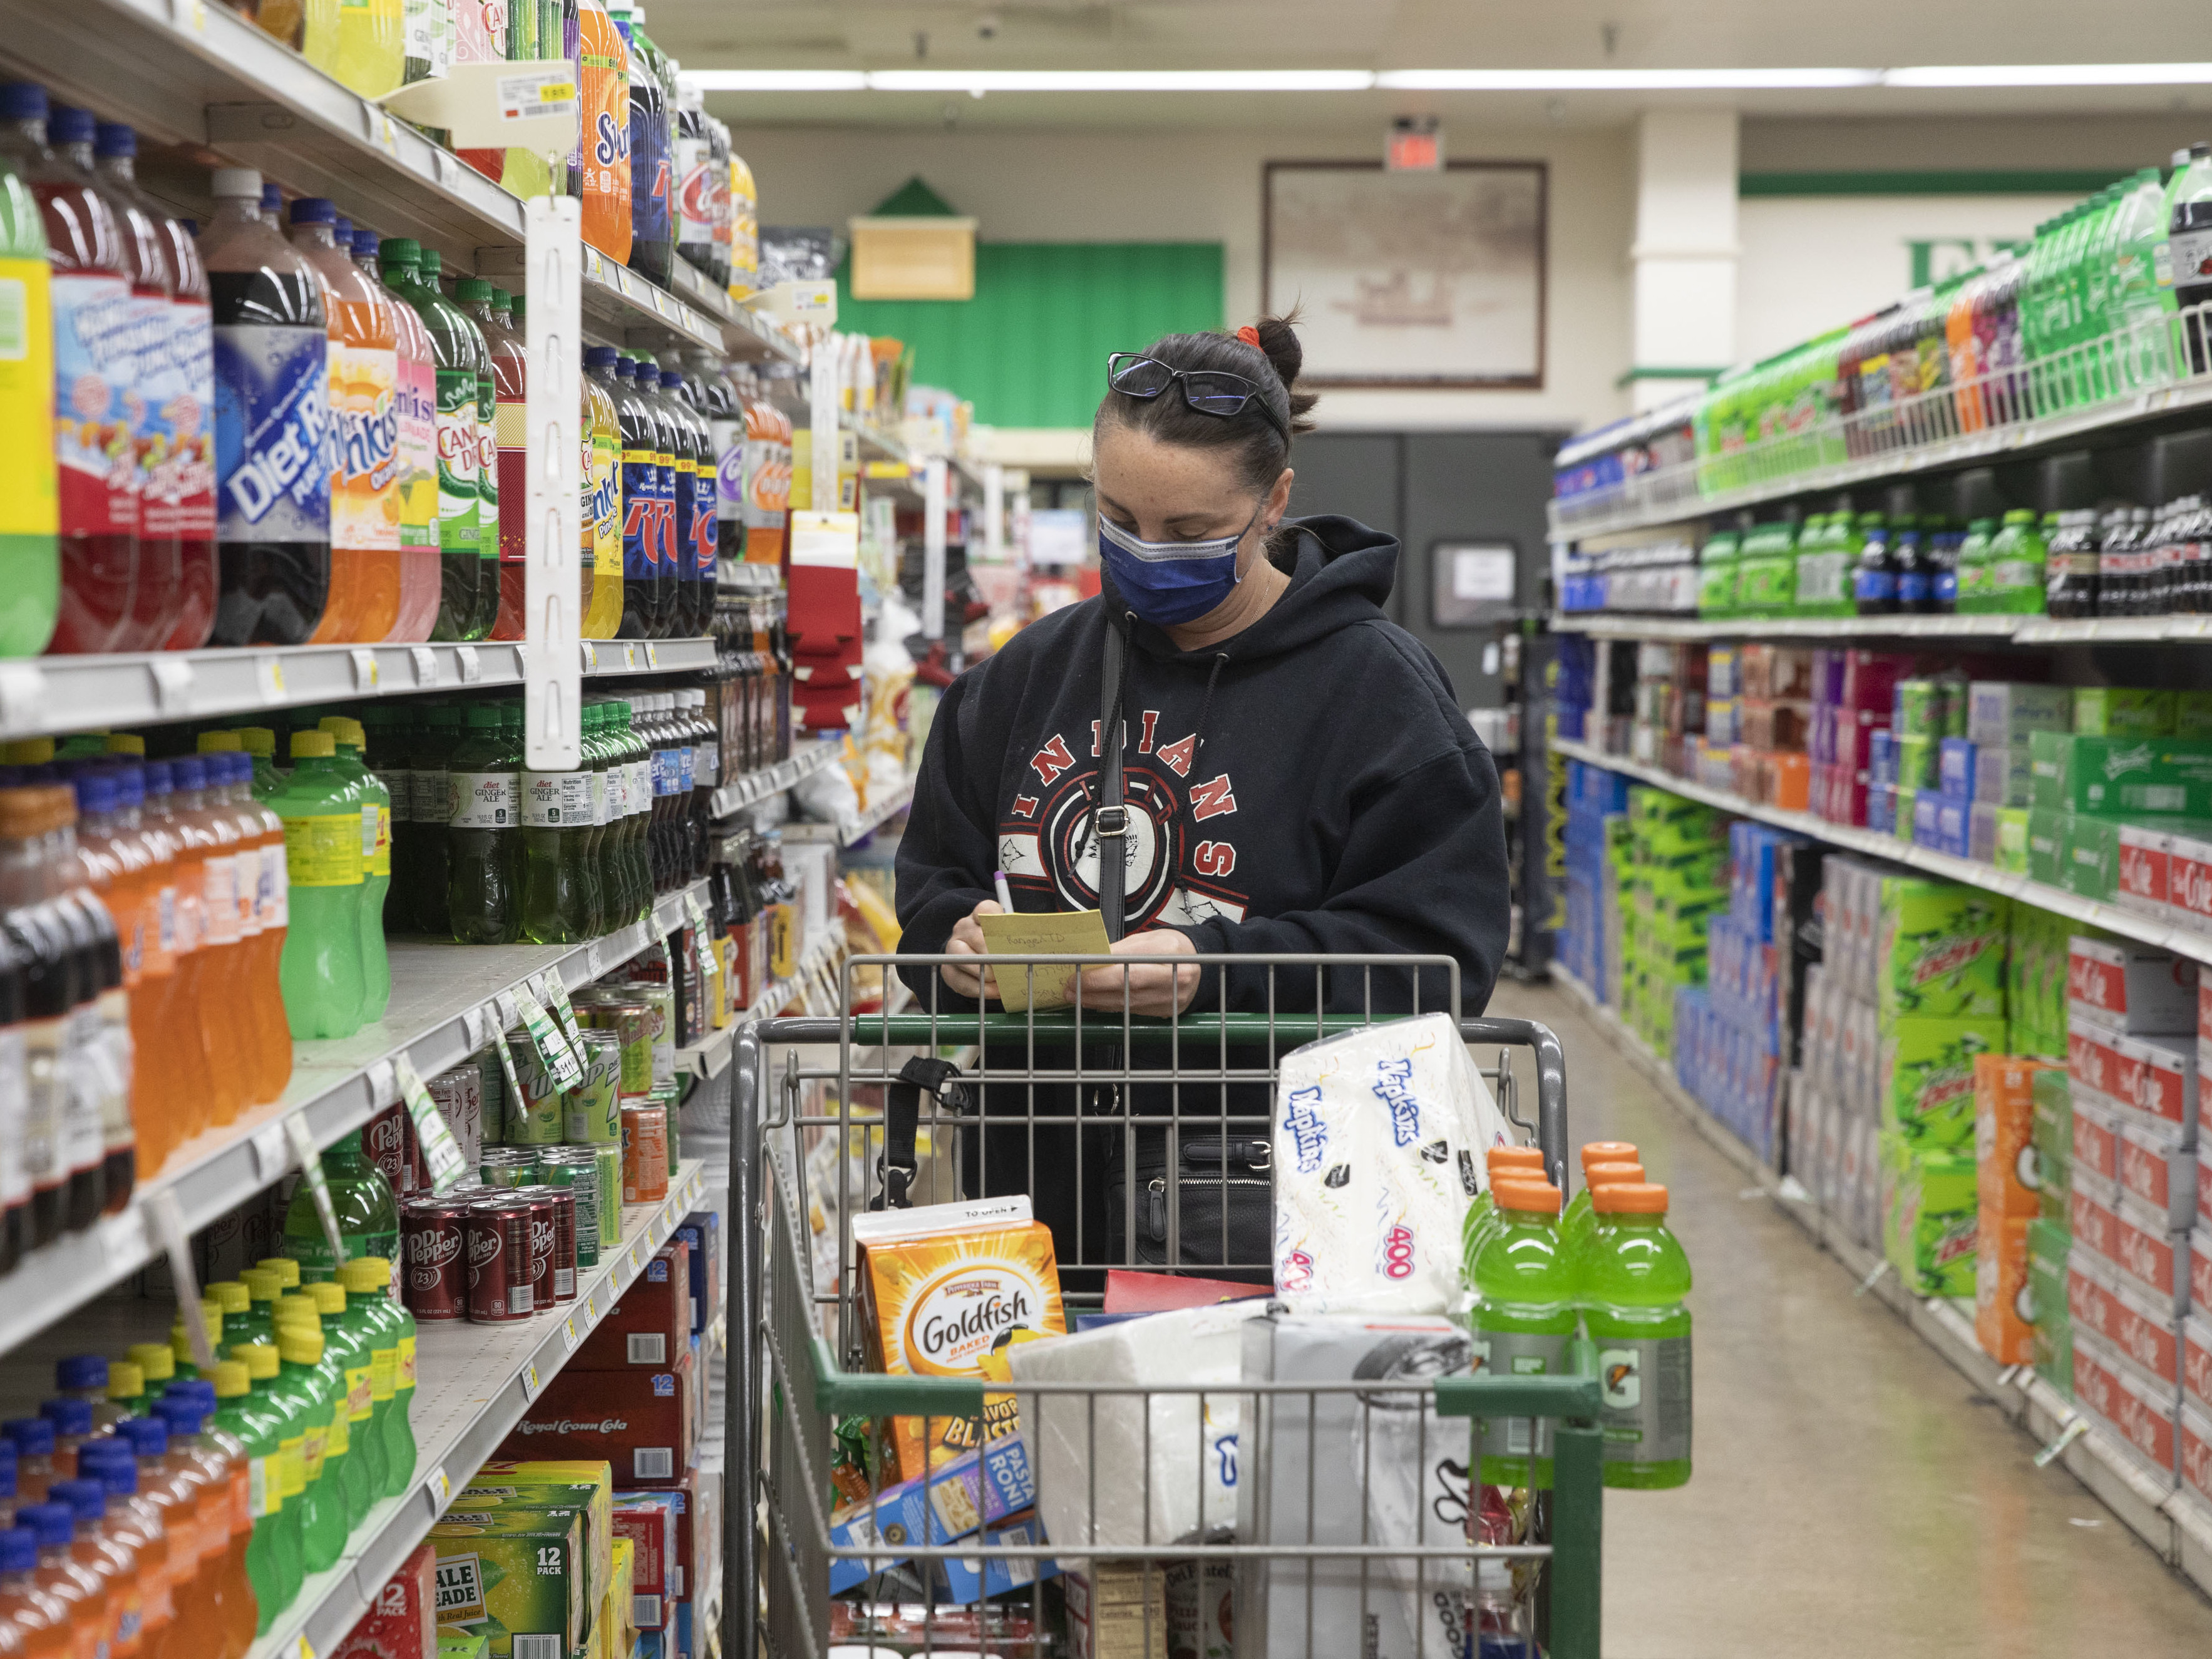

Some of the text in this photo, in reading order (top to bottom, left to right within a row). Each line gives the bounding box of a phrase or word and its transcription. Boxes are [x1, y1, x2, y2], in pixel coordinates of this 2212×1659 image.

[227, 420, 310, 525] Diet
[1371, 1057, 1421, 1148] Napkins
[1283, 1086, 1329, 1174] Napkins
[386, 1158, 397, 1170] 23
[422, 1230, 445, 1248] Dr
[676, 1228, 699, 1242] 12
[408, 1233, 460, 1265] Pepper
[1384, 1224, 1416, 1280] 400
[417, 1271, 430, 1284] 23
[647, 1260, 668, 1275] 12
[923, 1290, 1029, 1354] Goldfish
[950, 1335, 990, 1356] BAKED
[651, 1374, 674, 1390] 12
[1600, 1348, 1640, 1409] G
[516, 1419, 628, 1435] Royal Crown Cola
[989, 1454, 1025, 1507] RONI
[1006, 1447, 1035, 1501] PASTA
[537, 1546, 561, 1566] 12
[536, 1566, 562, 1576] PACK
[377, 1608, 408, 1617] PACK
[447, 1611, 463, 1621] Real
[463, 1609, 481, 1620] Juice
